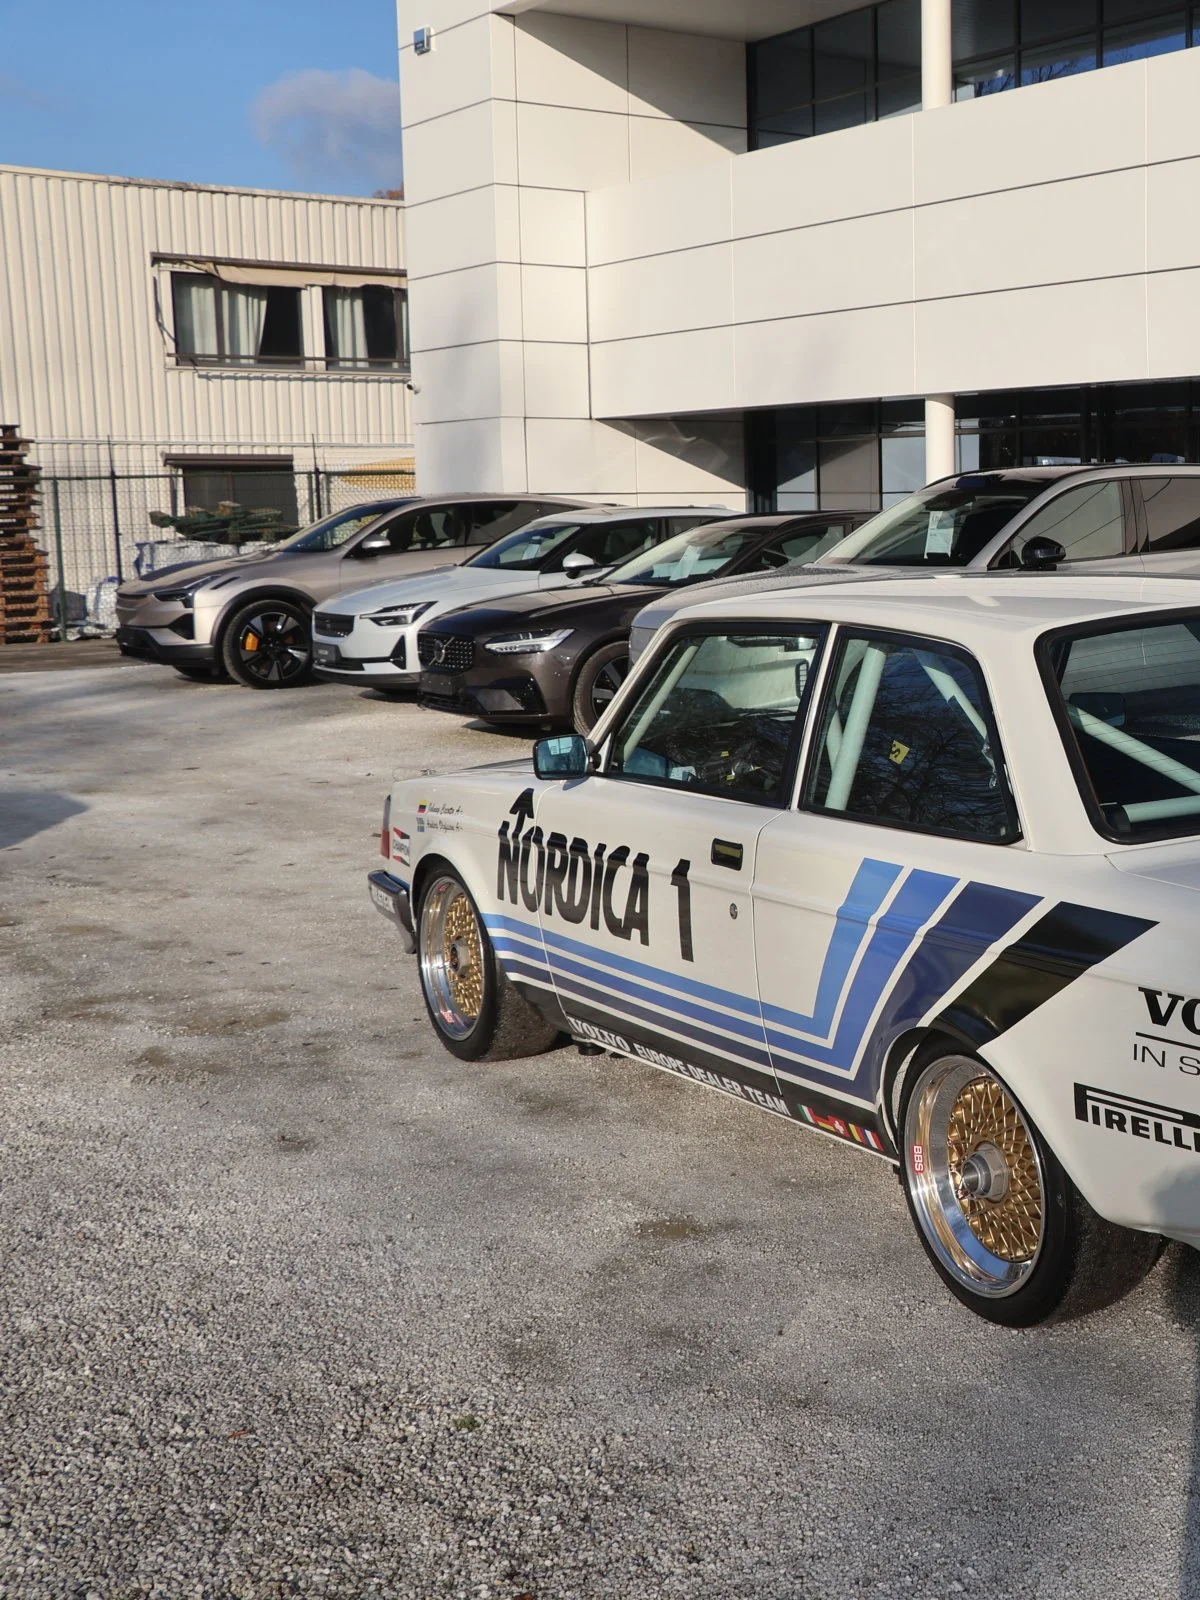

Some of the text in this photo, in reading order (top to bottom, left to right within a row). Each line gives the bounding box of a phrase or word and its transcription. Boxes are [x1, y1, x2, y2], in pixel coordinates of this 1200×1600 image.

[497, 787, 694, 963] NORDICA 1
[568, 1016, 792, 1117] VOLVO EUROPE DEALER TEAM
[1133, 1043, 1166, 1068] IN
[913, 1145, 924, 1172] BBS
